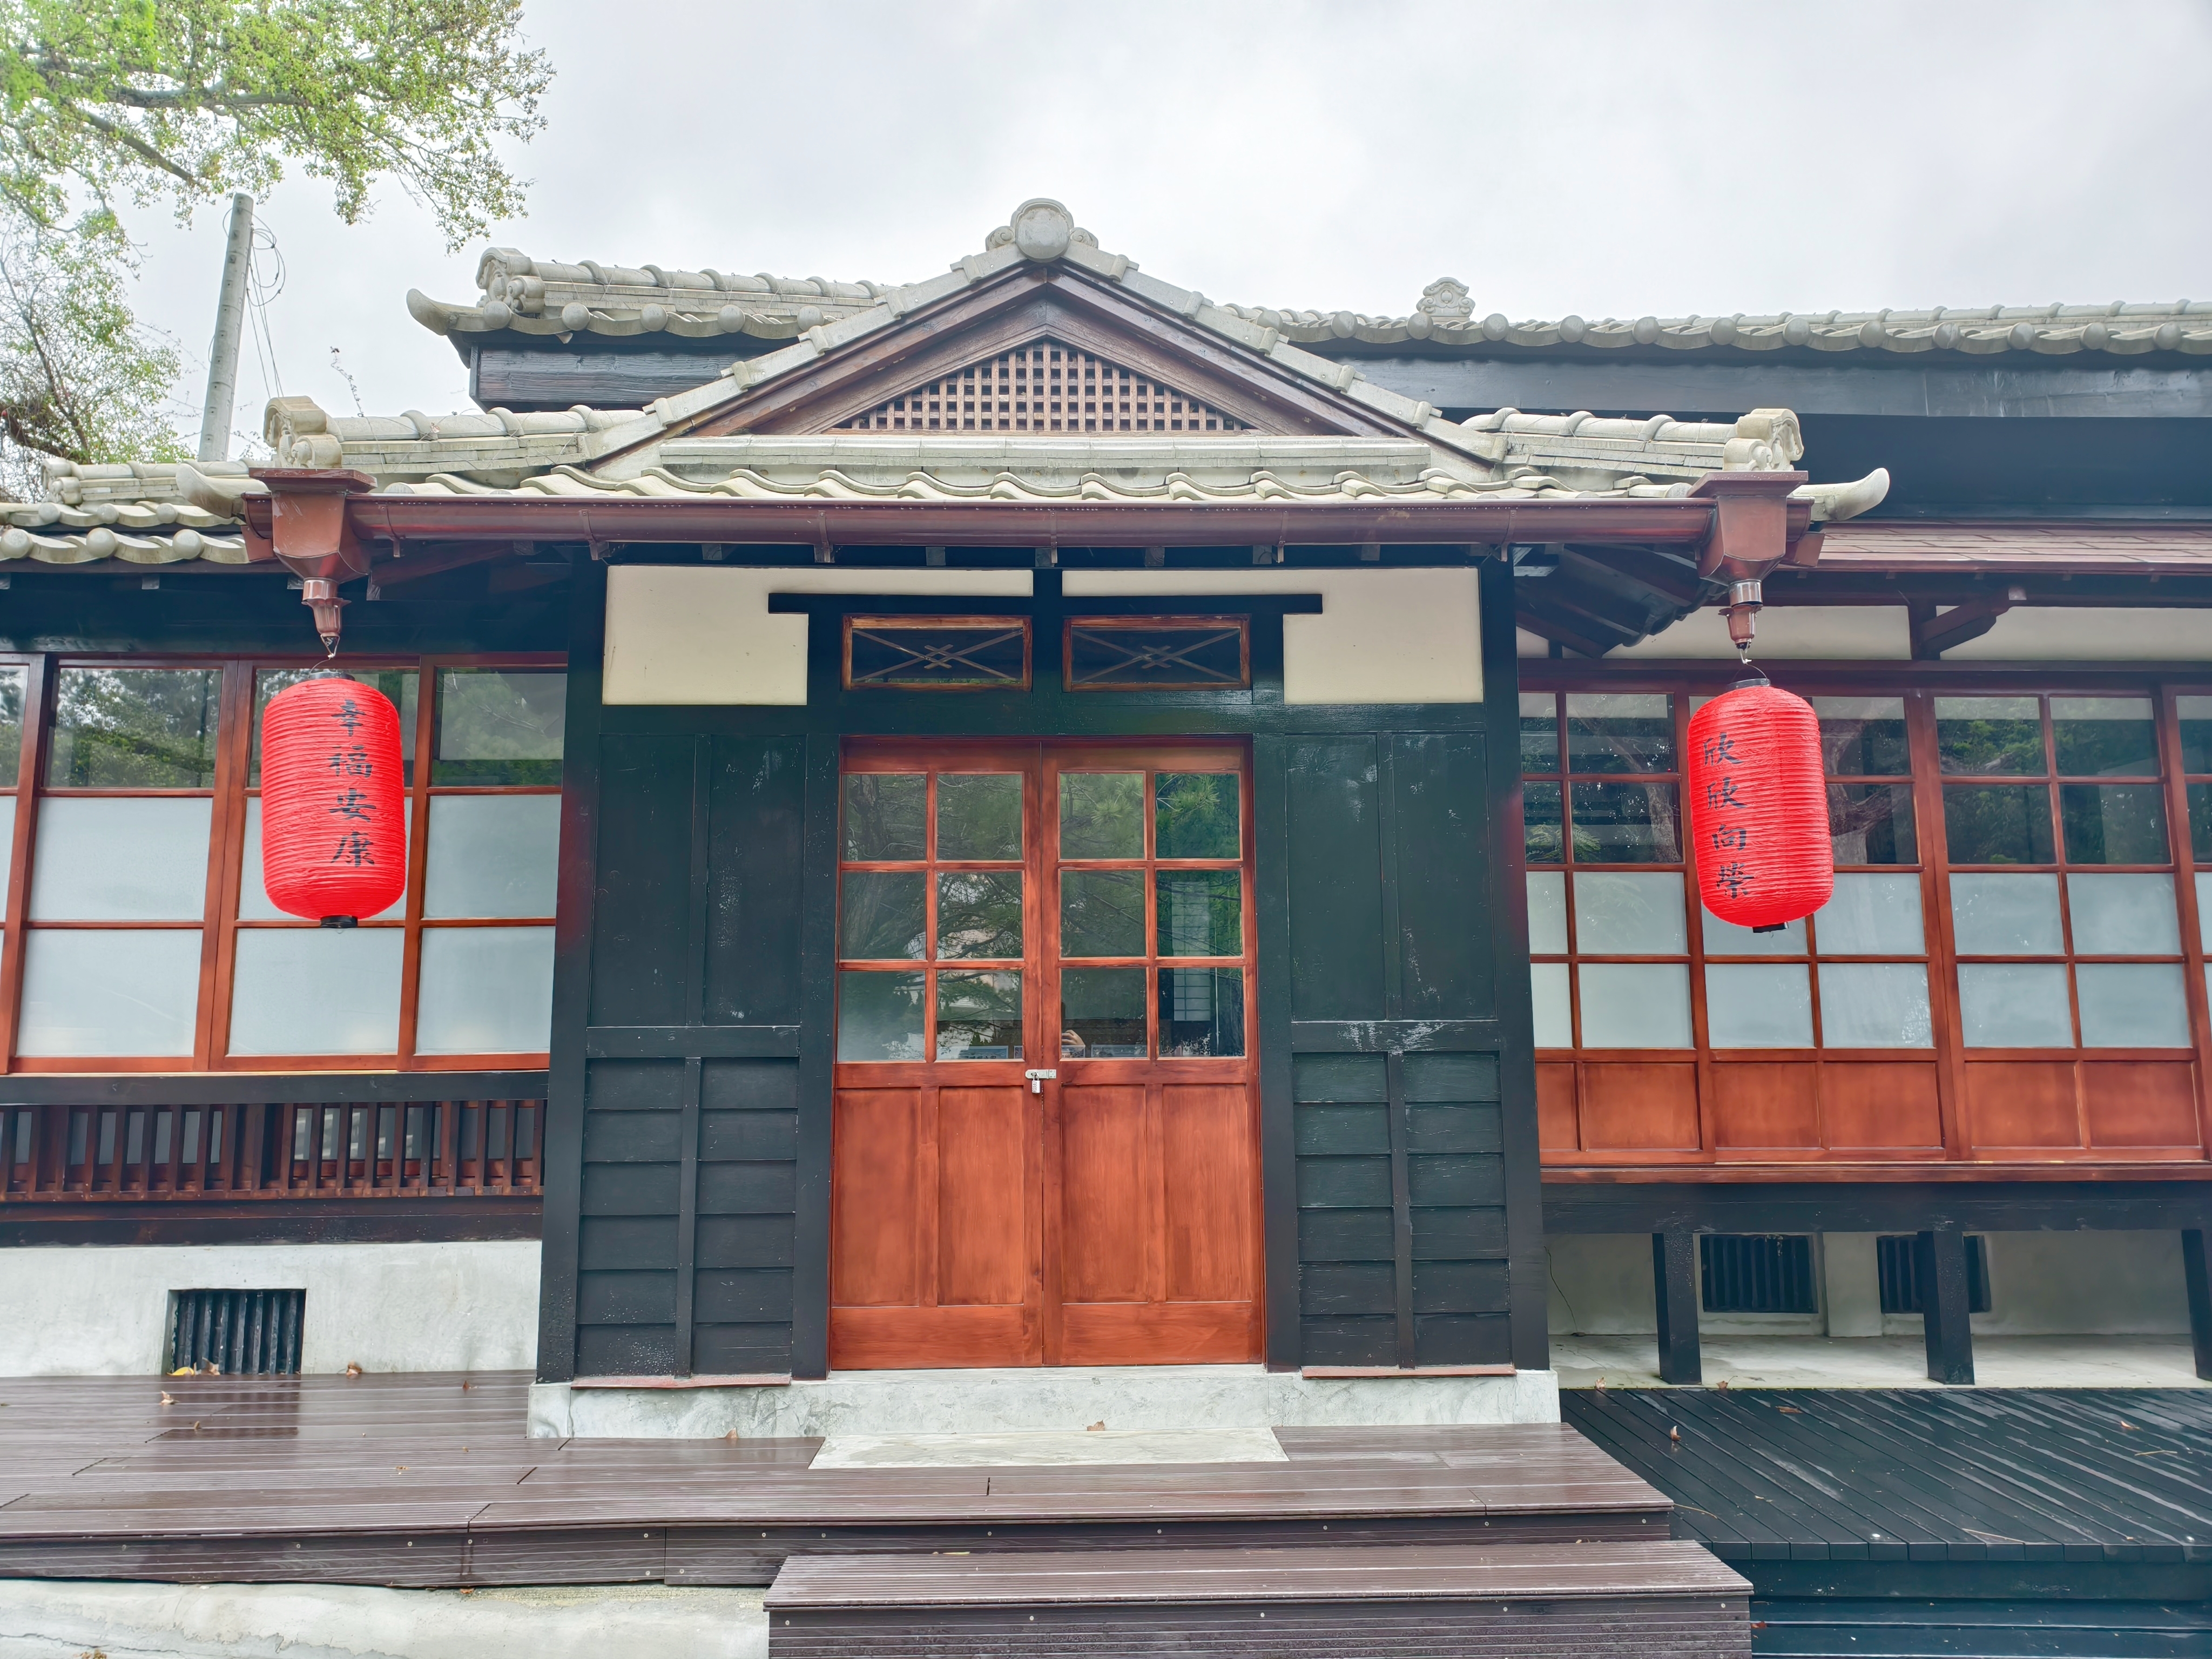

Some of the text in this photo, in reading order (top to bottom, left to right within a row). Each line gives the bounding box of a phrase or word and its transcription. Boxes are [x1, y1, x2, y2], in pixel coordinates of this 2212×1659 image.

[328, 698, 376, 868] 幸福安康
[1703, 732, 1755, 900] 欣欣向榮
